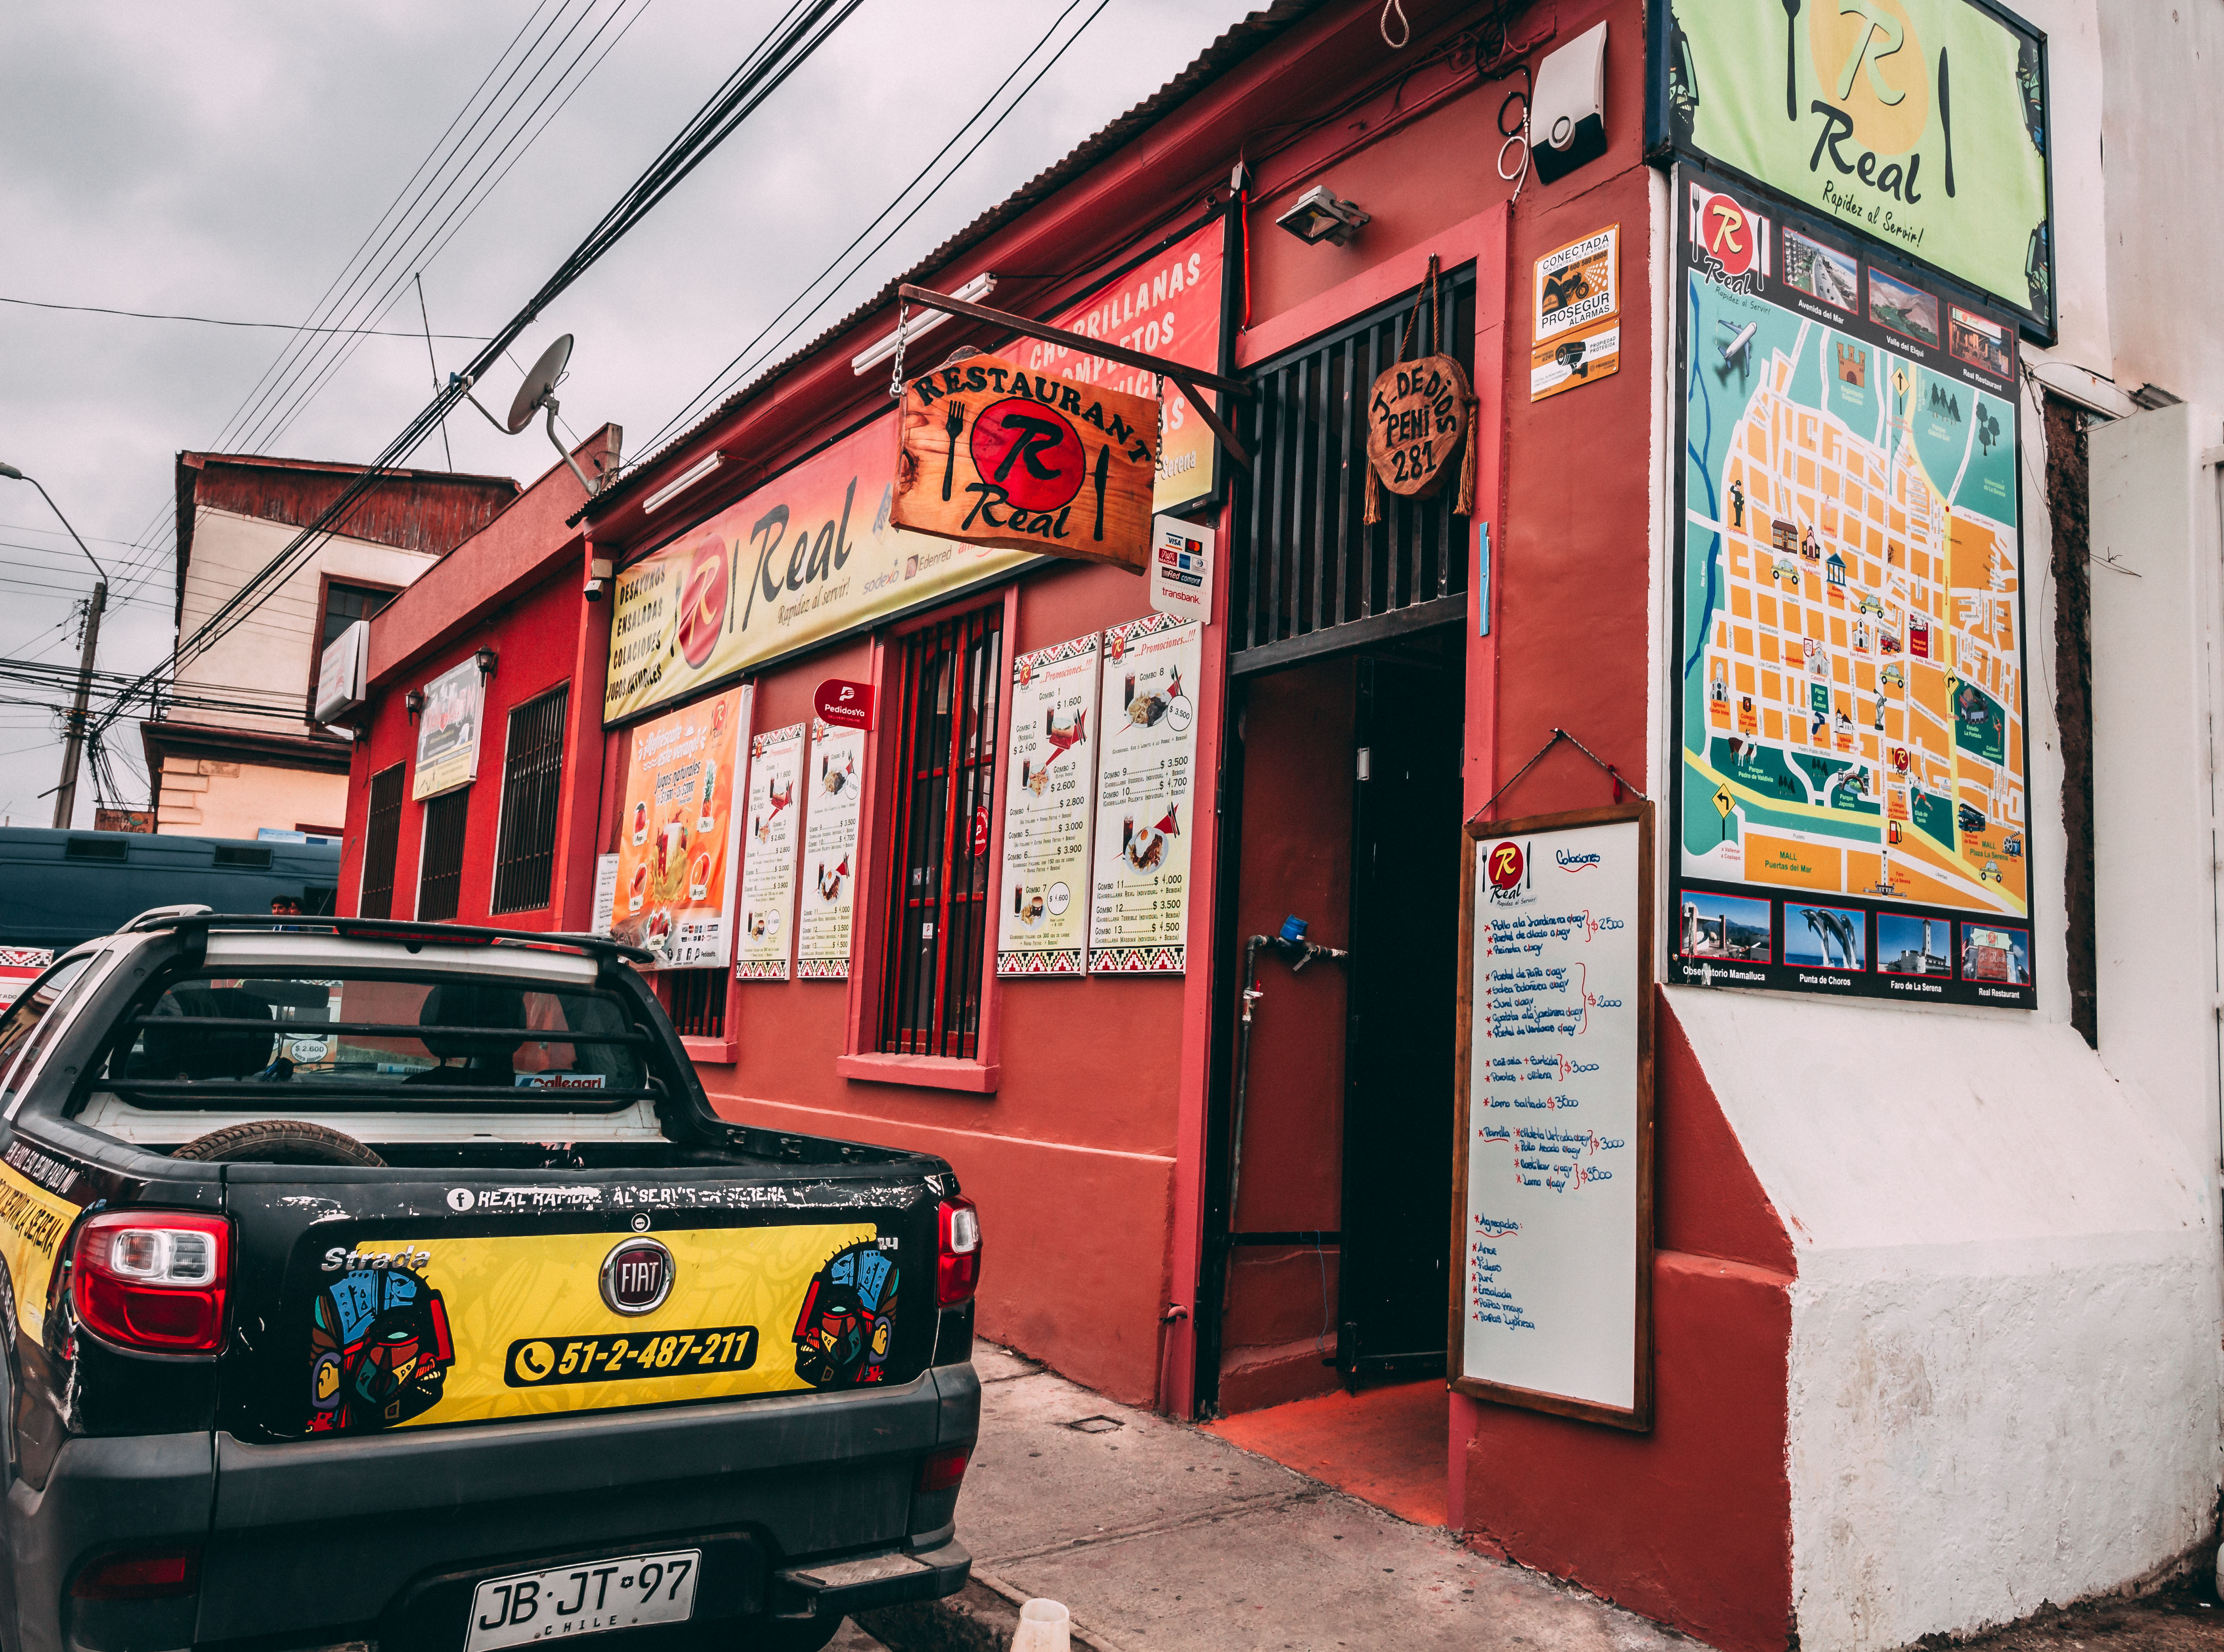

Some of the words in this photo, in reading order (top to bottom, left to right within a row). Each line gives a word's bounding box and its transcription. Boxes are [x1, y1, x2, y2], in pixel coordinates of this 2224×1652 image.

[1810, 100, 1921, 205] Real
[1822, 180, 1862, 217] Rapidez
[1867, 204, 1878, 224] al
[1883, 210, 1924, 248] Servir!
[1712, 204, 1743, 254] R
[1543, 234, 1609, 270] CONECTADA
[1553, 258, 1574, 270] CENTRAL
[1583, 243, 1609, 257] ALARMAS
[1570, 262, 1580, 271] 600
[1593, 250, 1607, 261] 8000
[1704, 256, 1752, 295] Real
[1542, 292, 1610, 328] PROSEGUR
[1715, 286, 1739, 304] Rapidez
[1742, 299, 1747, 307] al
[1750, 301, 1771, 315] Servir!
[1569, 304, 1610, 326] ALARMAS
[1798, 299, 1822, 316] Avenida
[1823, 310, 1832, 319] del
[1833, 314, 1844, 325] Mar
[1590, 336, 1616, 348] PROPIEDAD
[1590, 341, 1615, 354] PROTEGIDA
[1886, 336, 1899, 349] Valle
[1900, 341, 1909, 353] del
[1910, 345, 1924, 358] Elqui
[1962, 369, 1975, 380] Real
[1975, 372, 2002, 391] Restaurant
[912, 367, 1152, 463] RESTAURANT
[994, 413, 1064, 483] R
[1392, 440, 1437, 484] 281
[961, 482, 1071, 539] Real
[1167, 537, 1181, 546] VISA
[741, 476, 857, 632] Real
[919, 544, 952, 571] Edenred
[1159, 558, 1176, 566] MAGNA
[620, 564, 665, 606] DESAYUNOS
[862, 567, 899, 596] sodexo
[1167, 570, 1180, 580] Red
[1181, 575, 1200, 585] compra
[778, 590, 810, 626] Rapidez
[811, 592, 822, 612] al
[823, 580, 850, 608] servir!
[617, 597, 663, 637] ENSALADAS
[613, 630, 661, 670] COLACIONES
[1159, 667, 1164, 676] 8
[607, 679, 626, 703] JUGOS
[825, 704, 865, 717] PedidosYa
[1064, 696, 1081, 708] 1.600
[1175, 708, 1190, 720] 3.500
[1167, 756, 1188, 768] 3.500
[654, 772, 672, 794] Jugos
[672, 758, 701, 786] naturales
[1057, 780, 1075, 792] 2.600
[1066, 796, 1084, 807] 2.800
[1065, 821, 1083, 831] 3.000
[1064, 844, 1082, 854] 3.900
[1779, 851, 1797, 861] MALL
[1970, 848, 1984, 857] Plaza
[1992, 851, 2008, 861] Serena
[1982, 841, 1996, 850] MALL
[1765, 860, 1788, 870] Puertas
[1790, 863, 1799, 872] del
[1800, 865, 1811, 874] Mar
[1162, 873, 1182, 884] 4.000
[1490, 883, 1521, 903] Real
[1160, 899, 1181, 909] 3.500
[1160, 921, 1179, 932] 4.500
[1682, 966, 1727, 979] Observatorio
[1729, 970, 1766, 981] Mamalluca
[1799, 974, 1818, 984] Punta
[1819, 976, 1827, 984] de
[1828, 976, 1851, 987] Choros
[1891, 980, 1904, 989] Faro
[1905, 982, 1913, 990] de
[1914, 982, 1921, 990] La
[1922, 983, 1942, 993] Serena
[1978, 988, 1990, 997] Real
[1991, 989, 2020, 999] Restaurant
[478, 1190, 526, 1207] REAL
[877, 1237, 898, 1250] 1.4
[321, 1245, 431, 1272] Strada
[621, 1262, 659, 1293] FIAT
[559, 1331, 751, 1374] 51-2-487-211
[544, 1614, 618, 1636] CHILE
